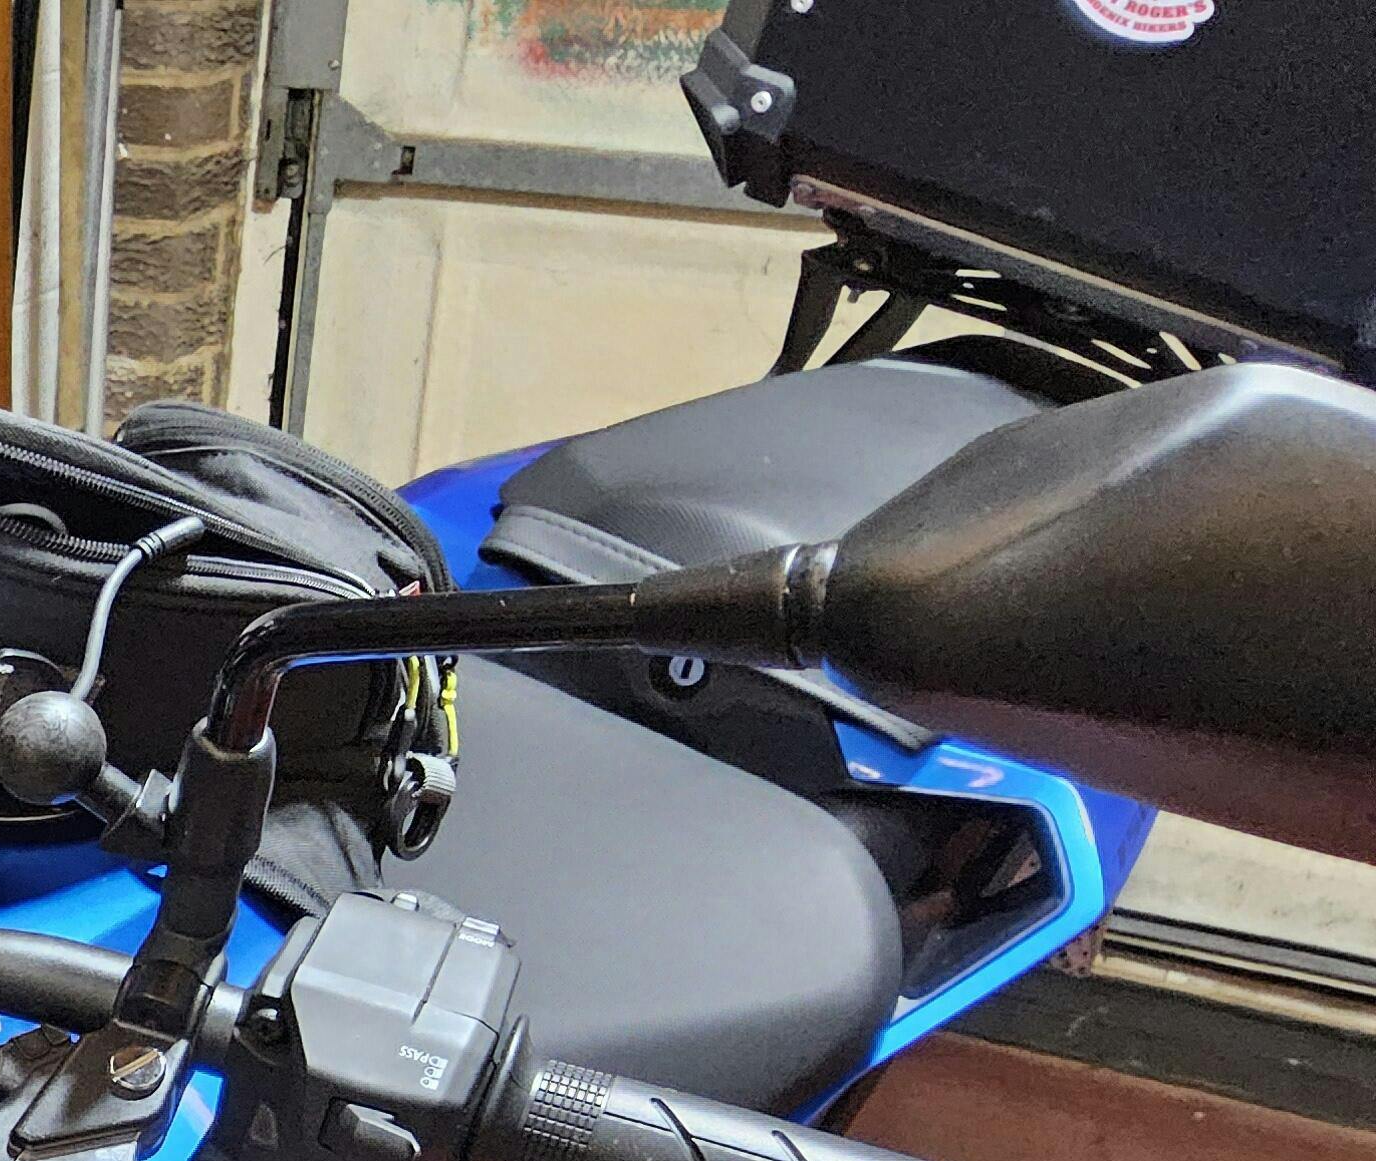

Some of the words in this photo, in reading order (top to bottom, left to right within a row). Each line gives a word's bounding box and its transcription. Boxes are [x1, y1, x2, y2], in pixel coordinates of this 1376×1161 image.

[1124, 0, 1208, 19] ROGER'S
[1133, 20, 1188, 33] BIKERS
[399, 1045, 430, 1064] PASS
